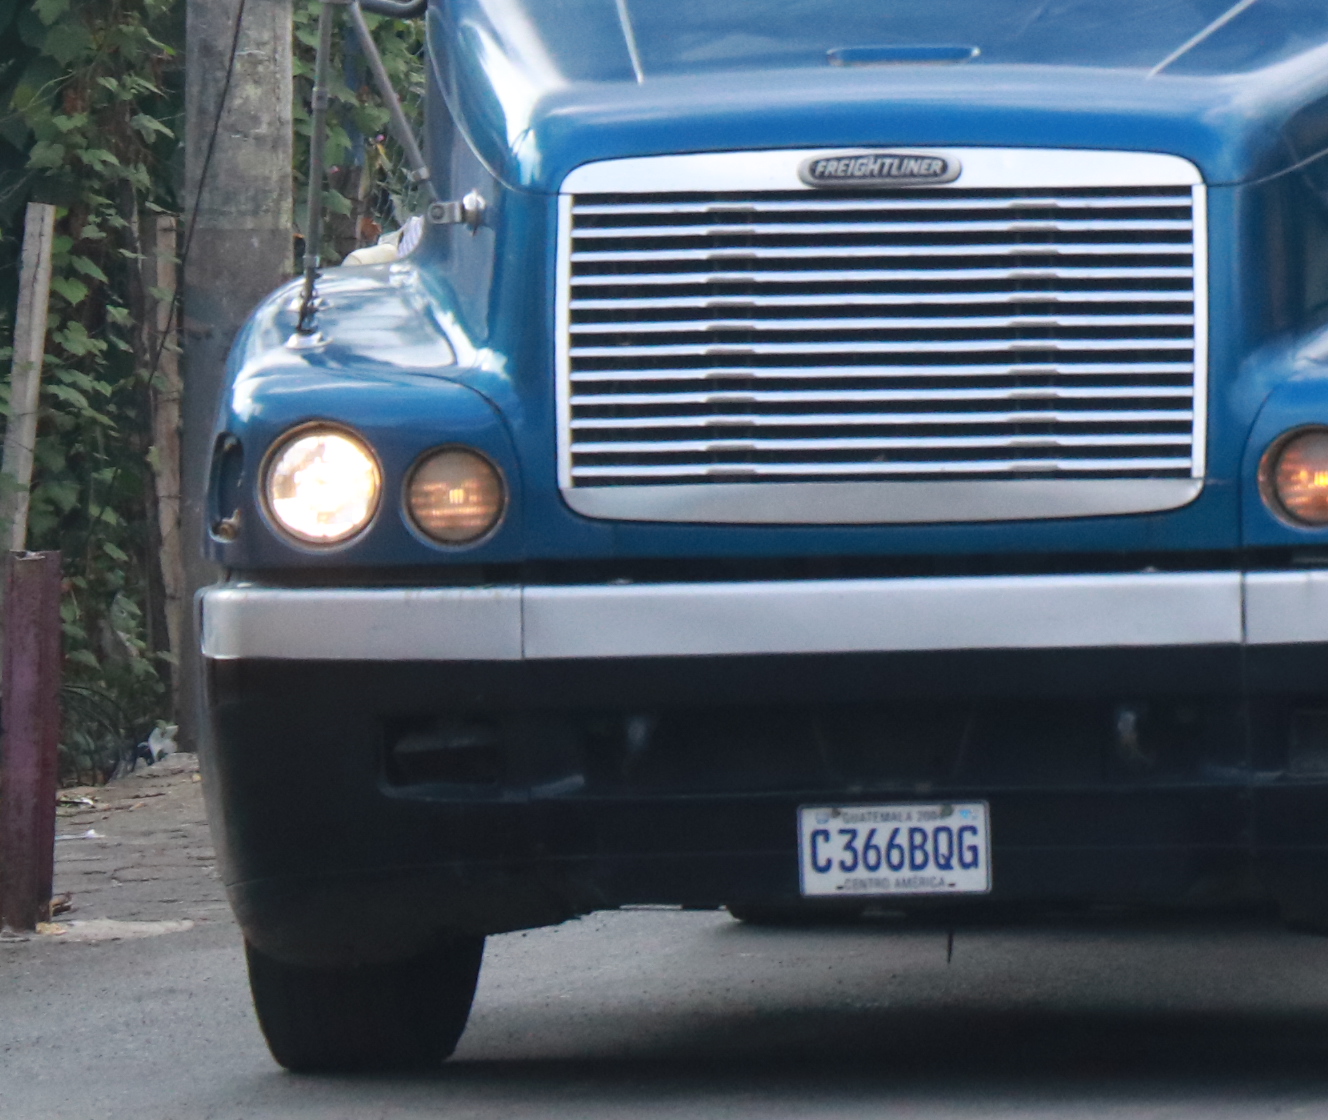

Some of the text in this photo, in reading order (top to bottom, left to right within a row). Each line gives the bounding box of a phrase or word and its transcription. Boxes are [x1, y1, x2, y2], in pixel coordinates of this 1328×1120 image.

[814, 155, 944, 177] FREIGHTLINER
[810, 825, 979, 874] C366BQG
[844, 878, 889, 890] CENTRO
